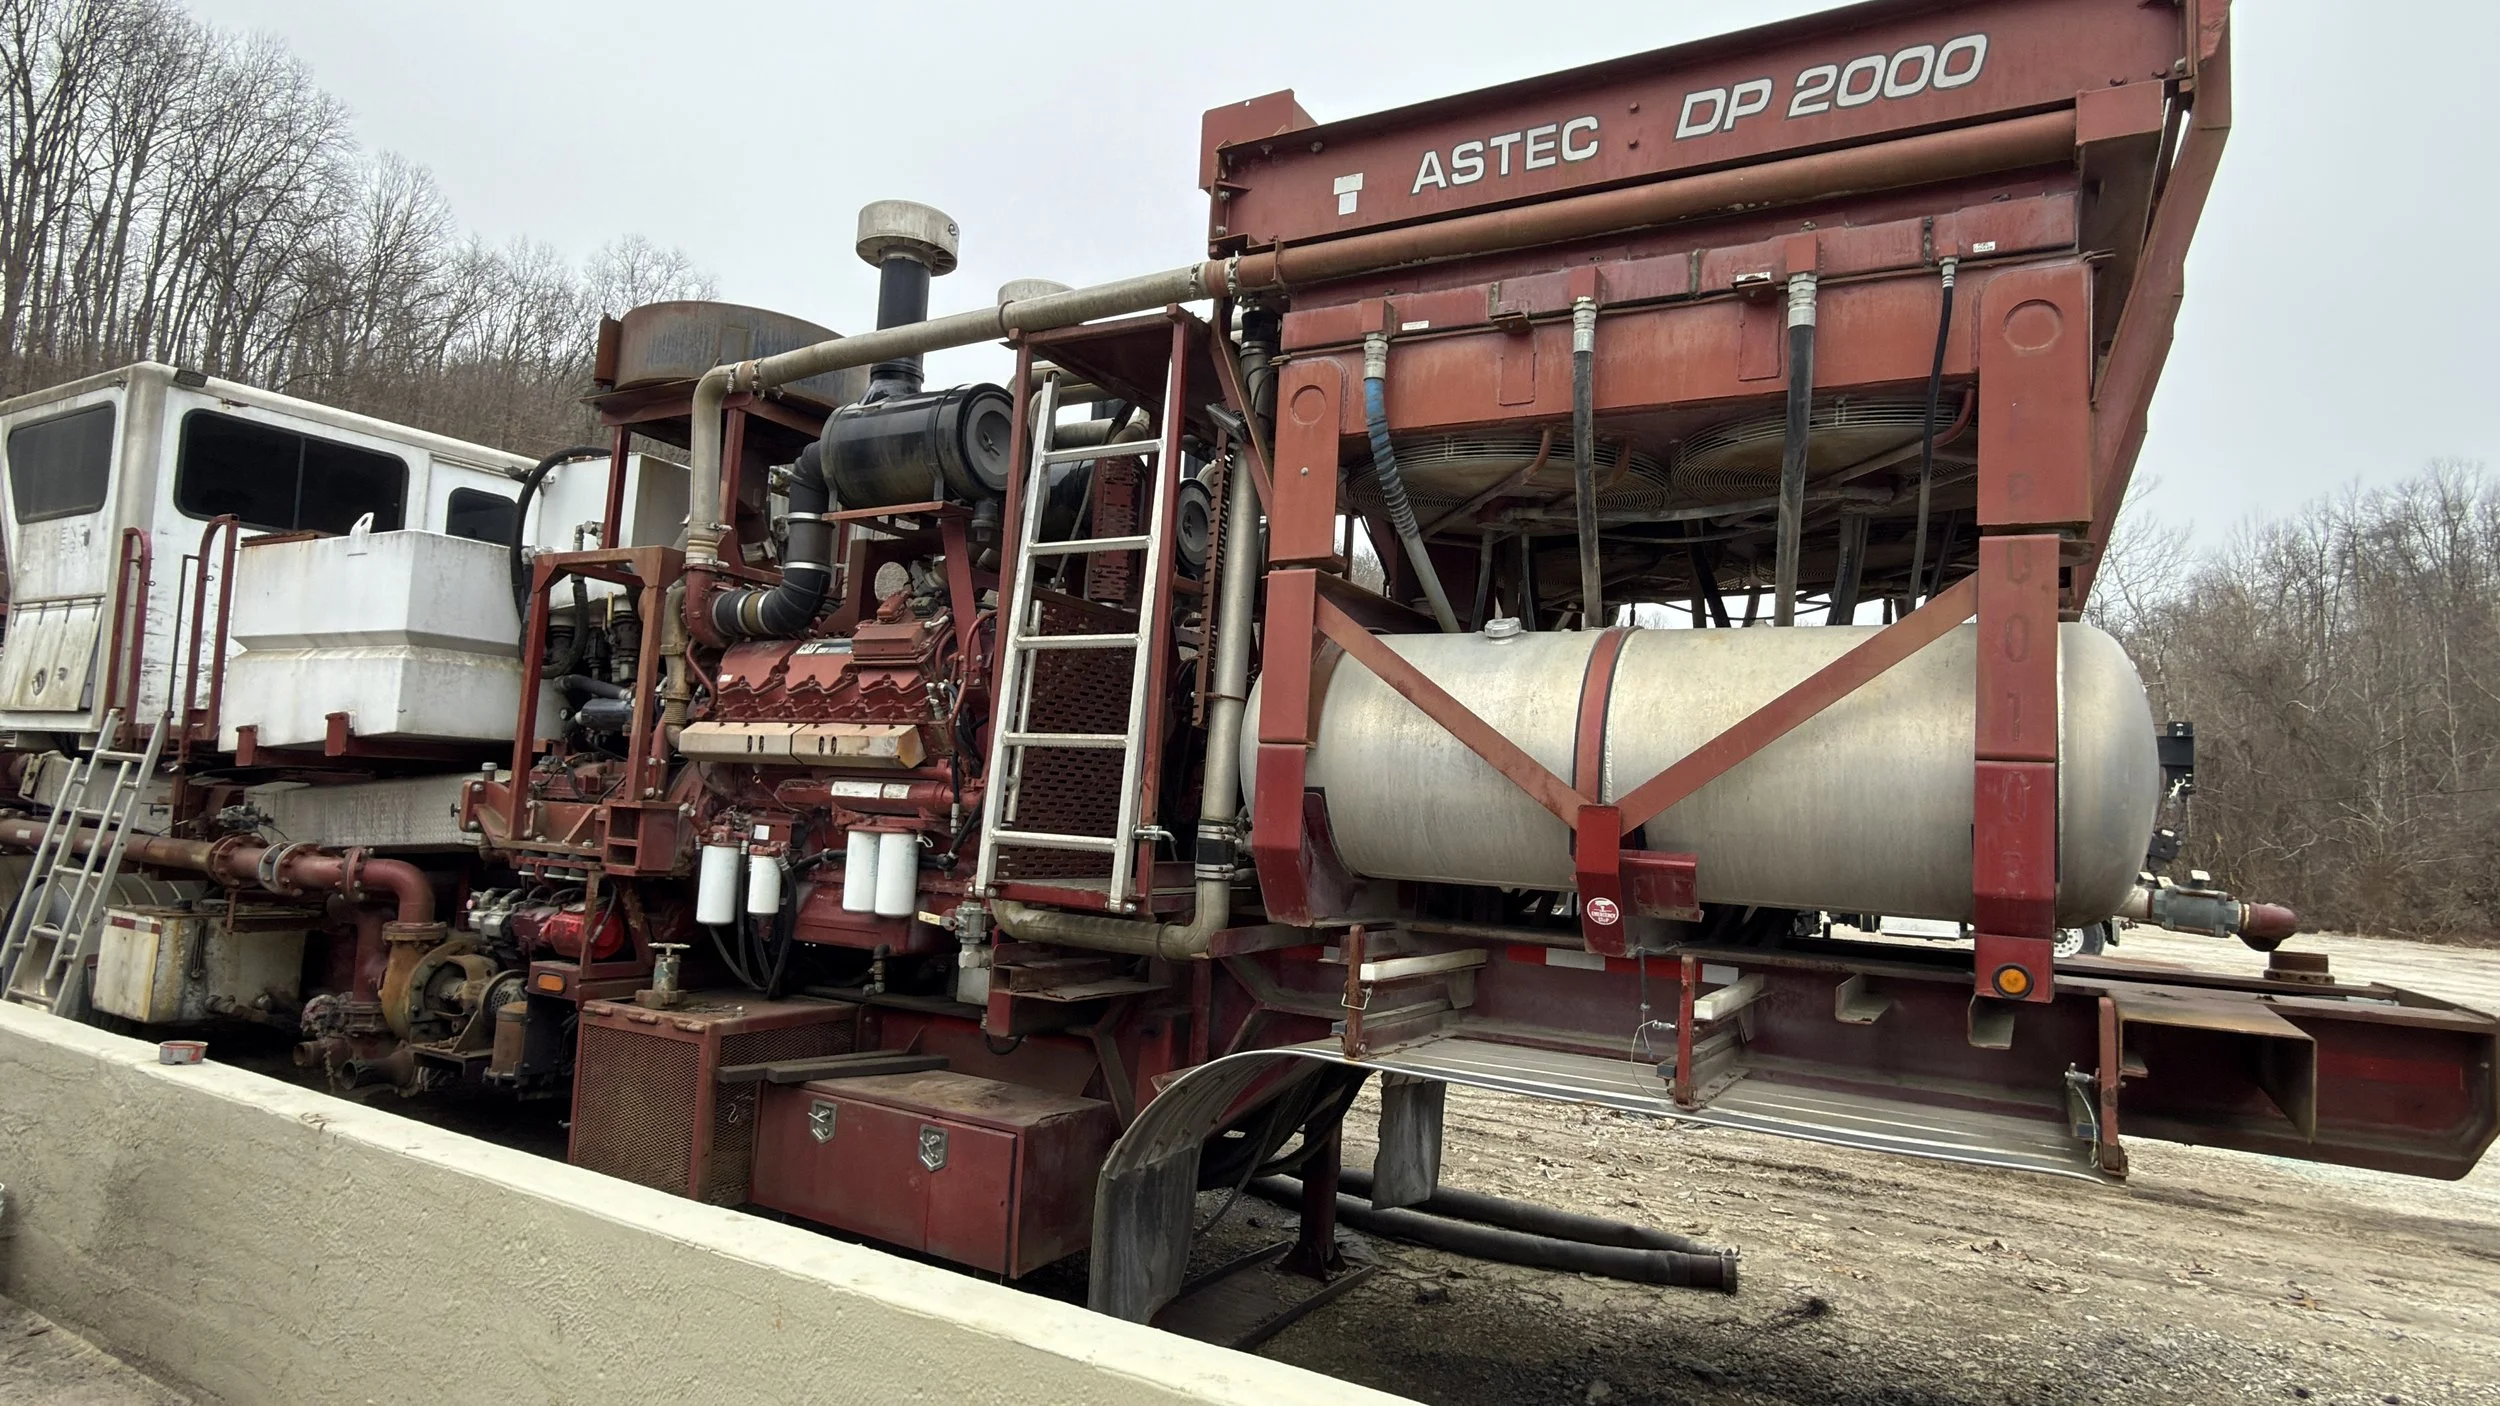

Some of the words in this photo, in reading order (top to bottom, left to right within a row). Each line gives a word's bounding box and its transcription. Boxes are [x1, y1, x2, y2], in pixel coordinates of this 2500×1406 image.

[1411, 115, 1599, 195] ASTEC
[1675, 77, 1772, 139] DP
[1787, 33, 1987, 117] 2000
[795, 643, 822, 655] CAT
